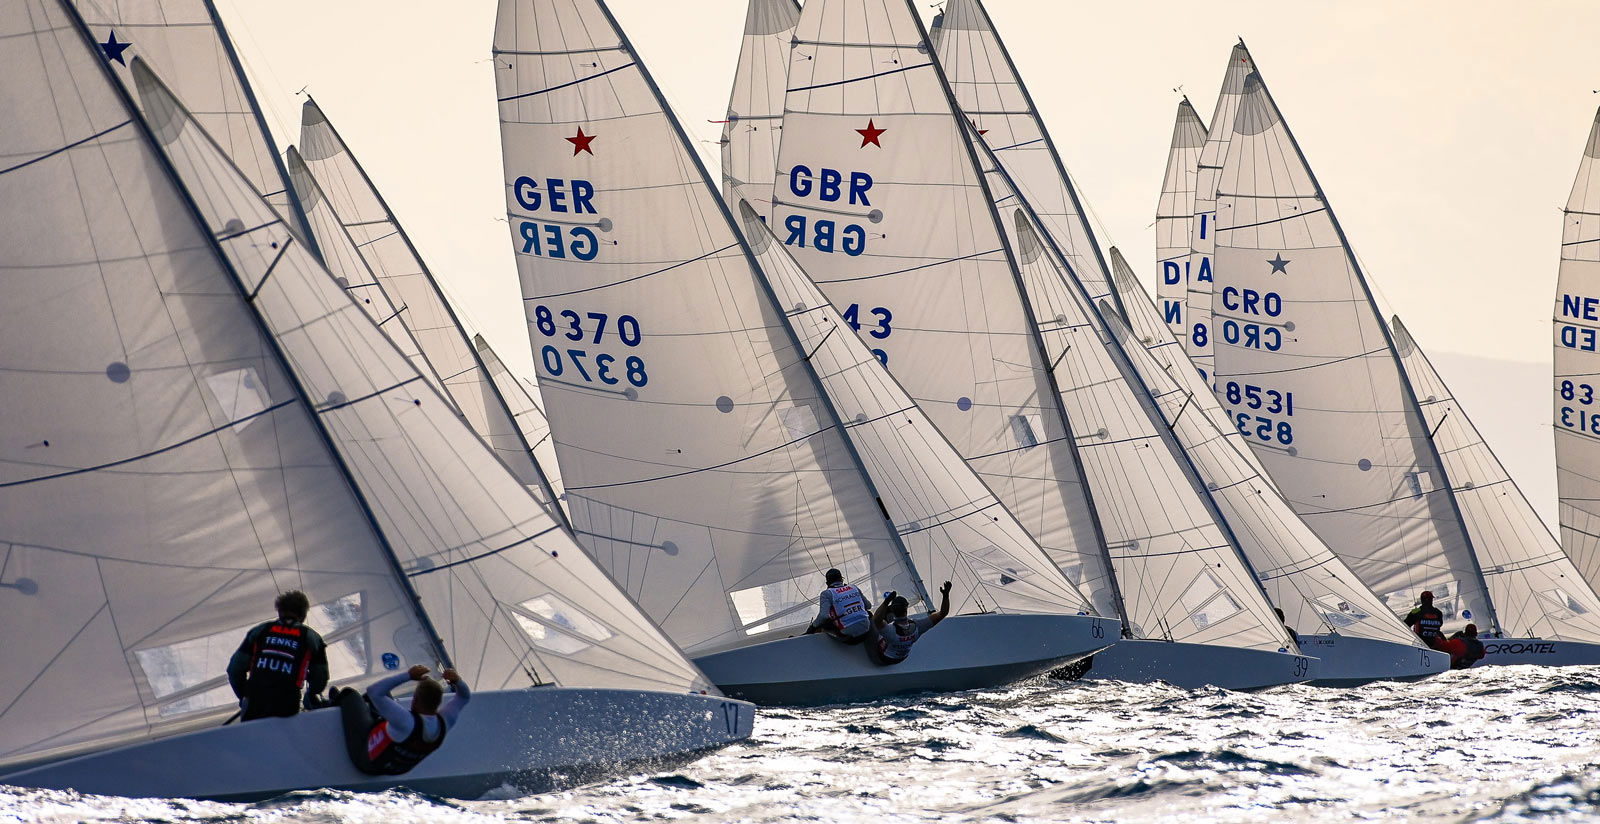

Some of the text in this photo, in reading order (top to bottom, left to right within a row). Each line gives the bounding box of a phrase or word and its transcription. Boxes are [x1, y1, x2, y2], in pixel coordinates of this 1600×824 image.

[514, 176, 597, 214] GER
[789, 165, 873, 207] GBR
[1222, 286, 1282, 317] CRO
[535, 305, 643, 347] 8370
[1192, 322, 1208, 347] 8
[1226, 381, 1293, 417] 8531
[1561, 380, 1594, 405] 83
[847, 605, 862, 615] GER
[1091, 617, 1105, 640] 66
[265, 636, 298, 649] TENKE
[1484, 643, 1557, 655] CROATEL
[256, 657, 293, 675] HUN
[1293, 656, 1309, 678] 39
[1417, 647, 1431, 668] 75
[720, 702, 739, 734] 17
